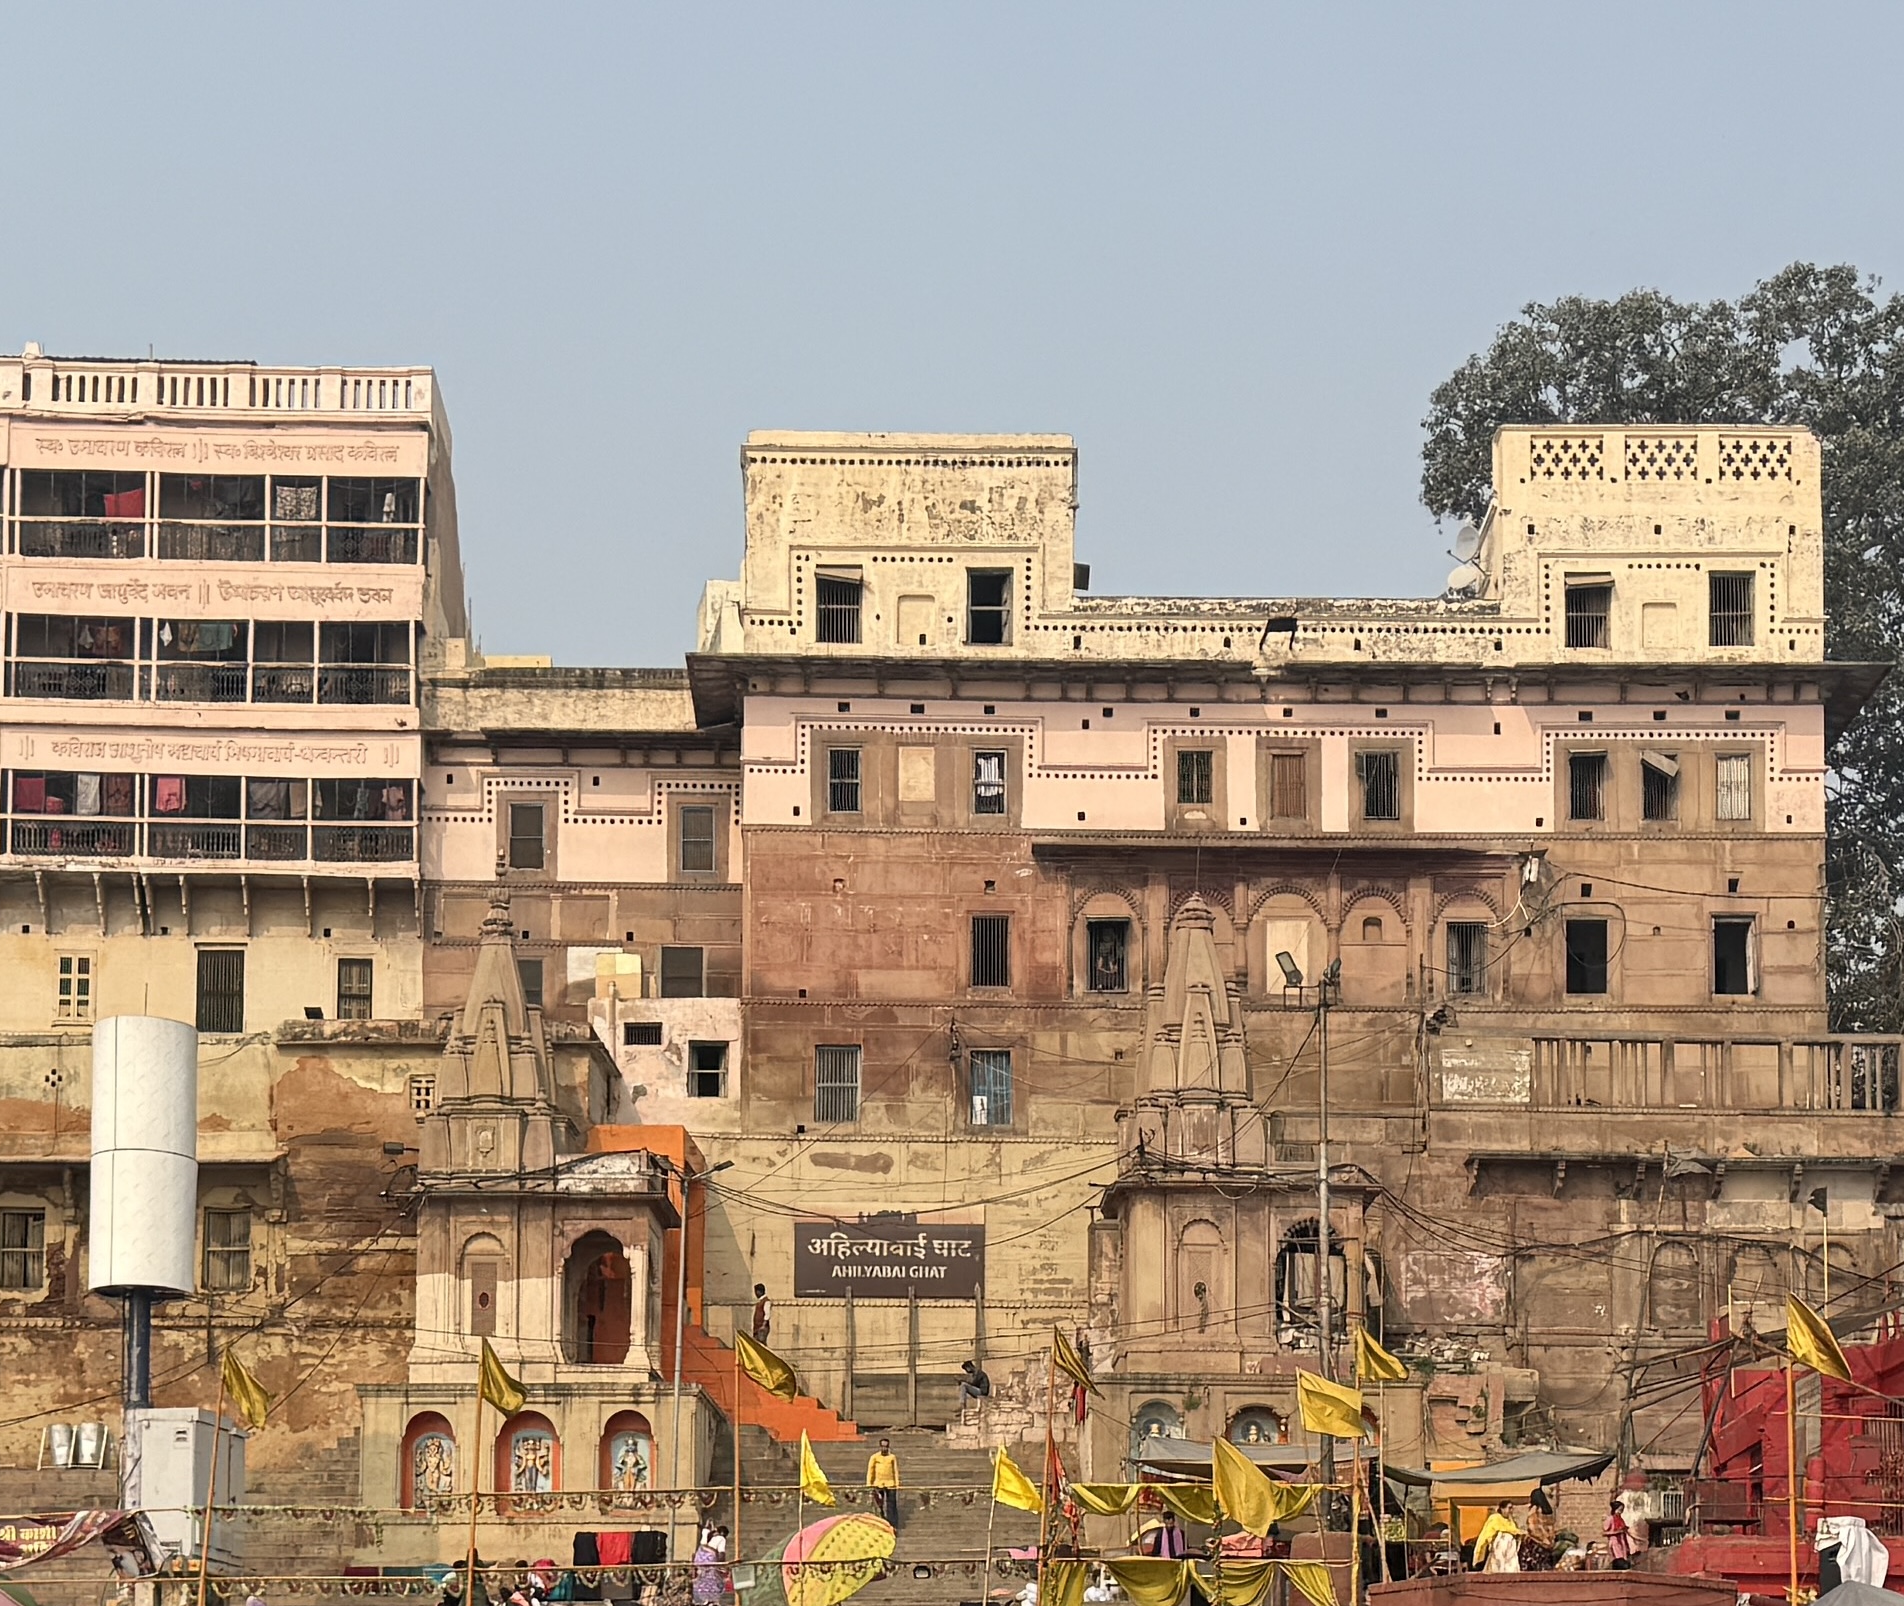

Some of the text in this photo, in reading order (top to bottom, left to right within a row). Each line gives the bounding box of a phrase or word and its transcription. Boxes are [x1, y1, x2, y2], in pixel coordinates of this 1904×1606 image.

[933, 1239, 972, 1258] घाट
[831, 1265, 948, 1280] AHILYABAI GHAT
